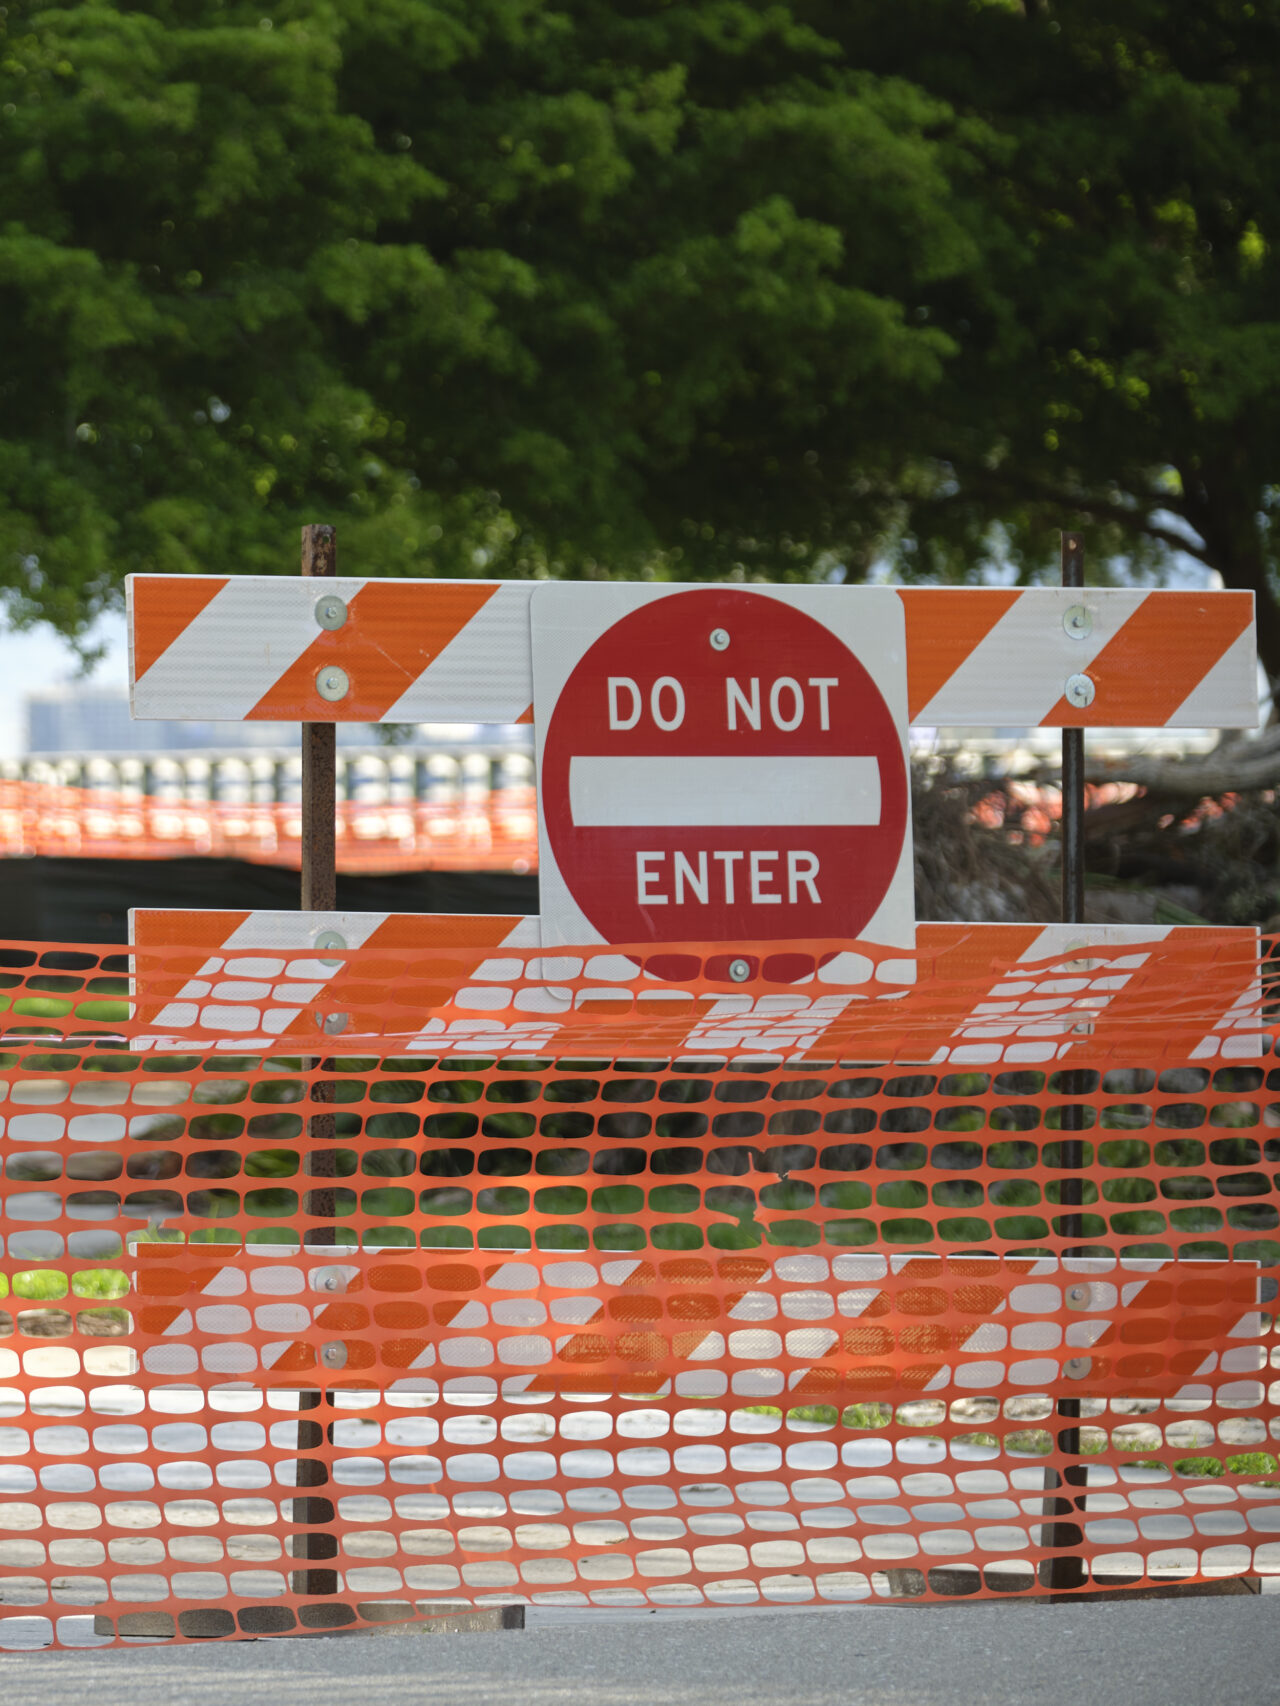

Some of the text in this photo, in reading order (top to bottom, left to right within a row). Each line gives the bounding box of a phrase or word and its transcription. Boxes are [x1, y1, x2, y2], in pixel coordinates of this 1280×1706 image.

[607, 676, 839, 732] DO NOT
[635, 850, 822, 905] ENTER
